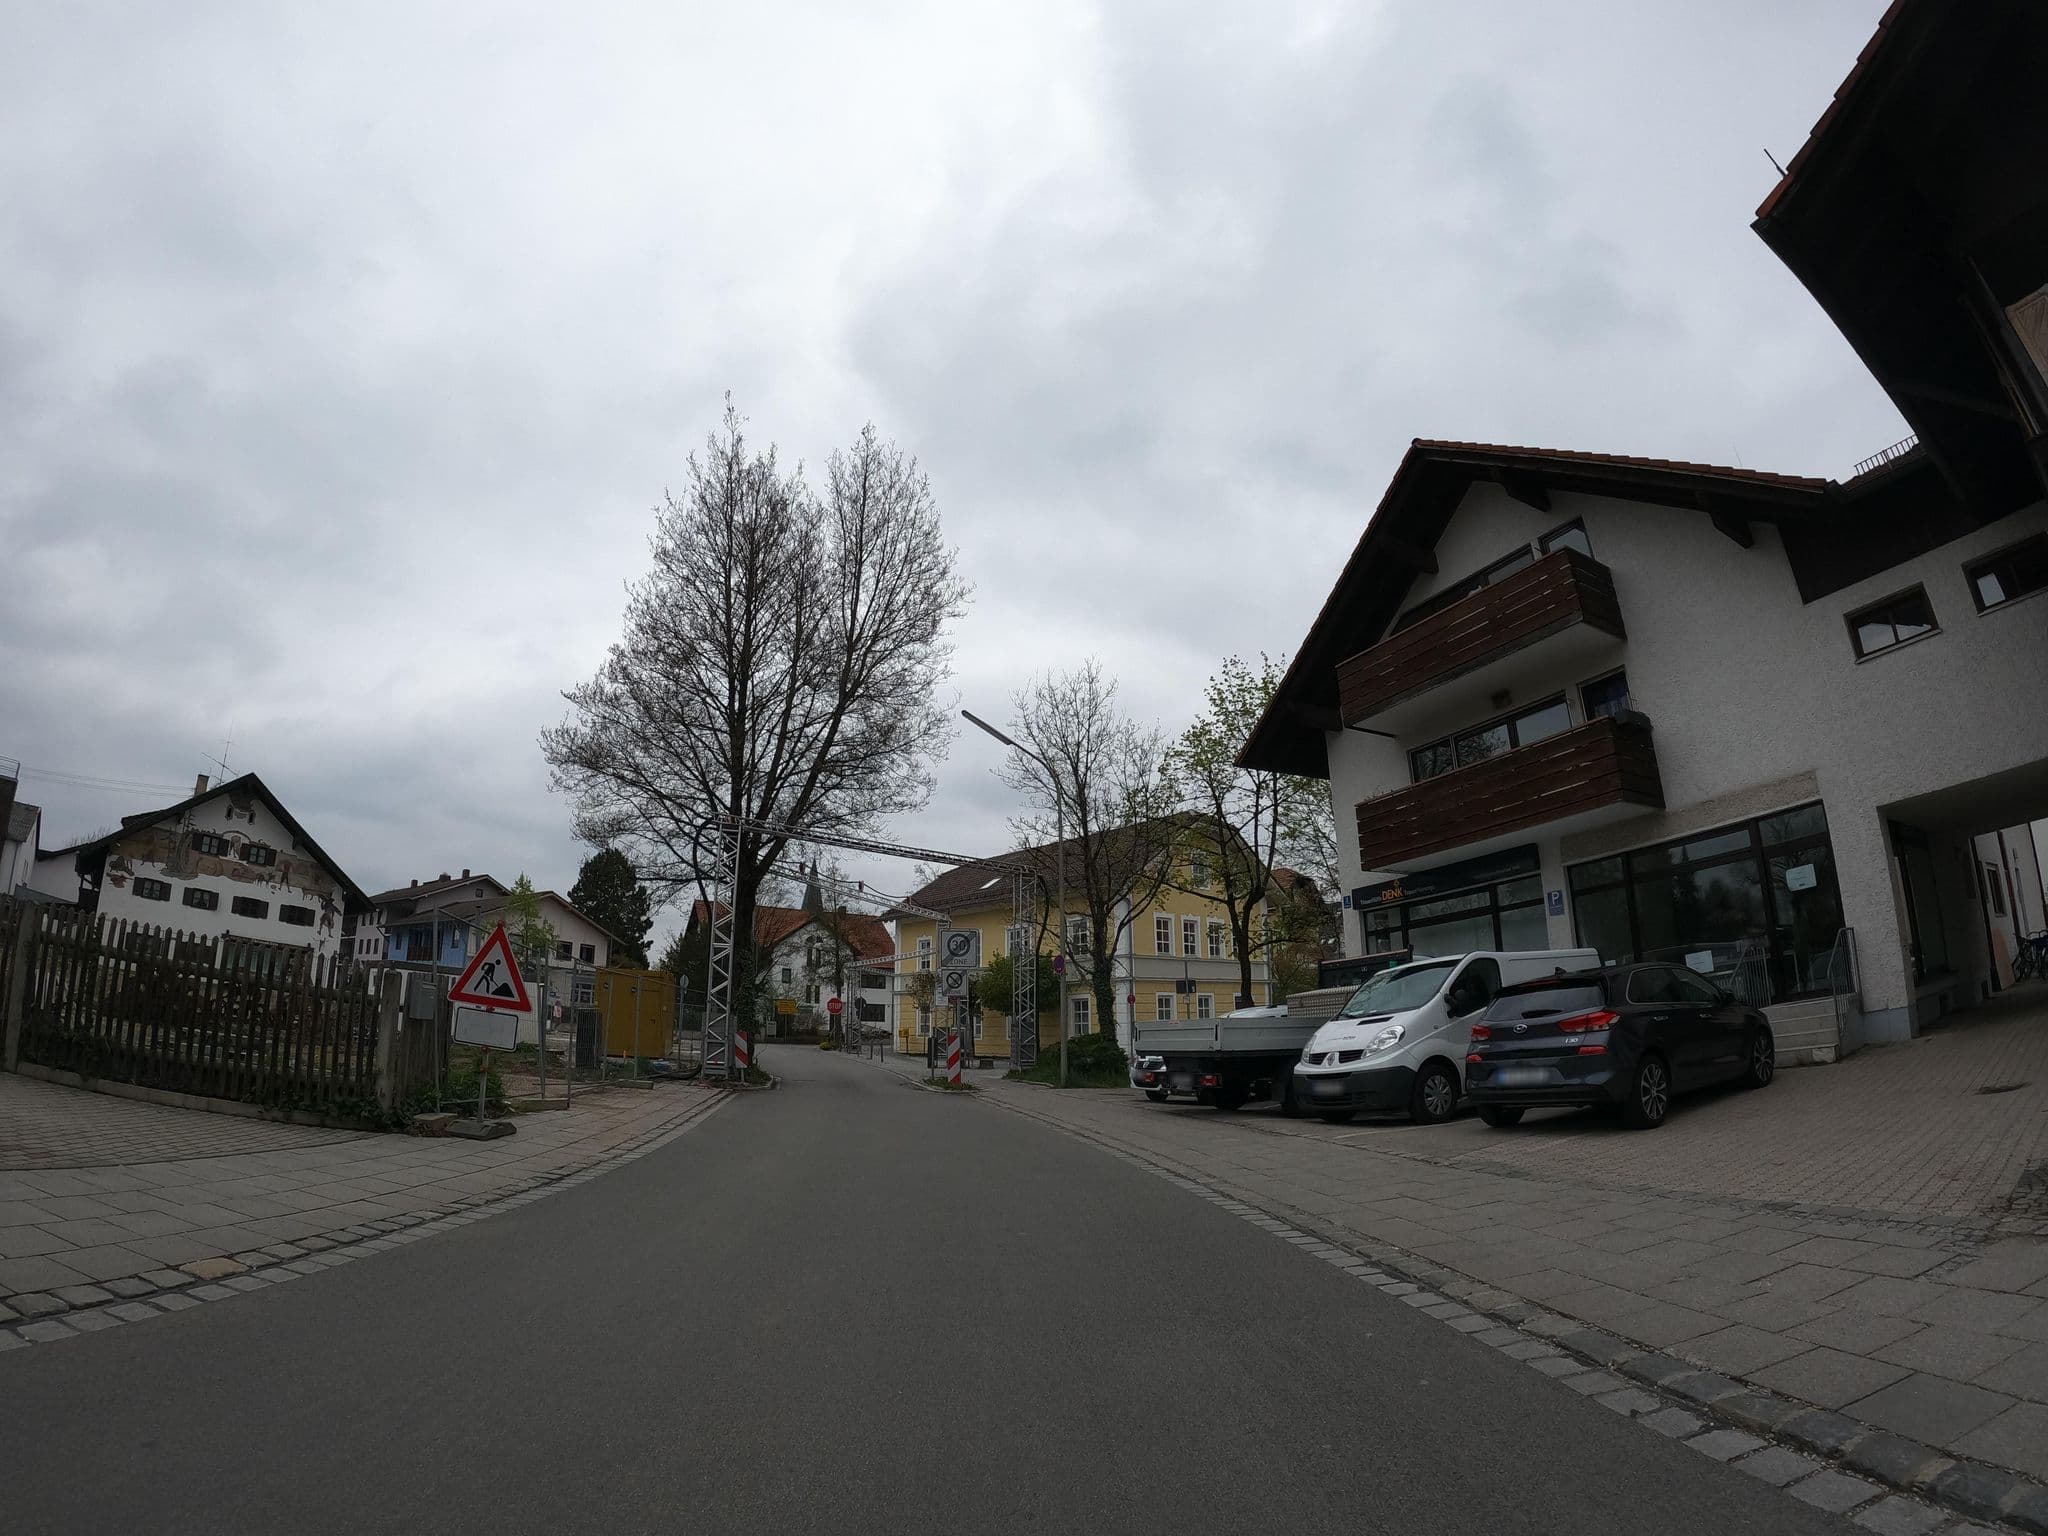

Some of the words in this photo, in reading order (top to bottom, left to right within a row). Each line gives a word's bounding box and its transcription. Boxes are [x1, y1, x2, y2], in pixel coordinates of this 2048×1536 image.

[1381, 887, 1404, 901] DENK
[952, 940, 966, 951] 30
[828, 1002, 842, 1010] STOP
